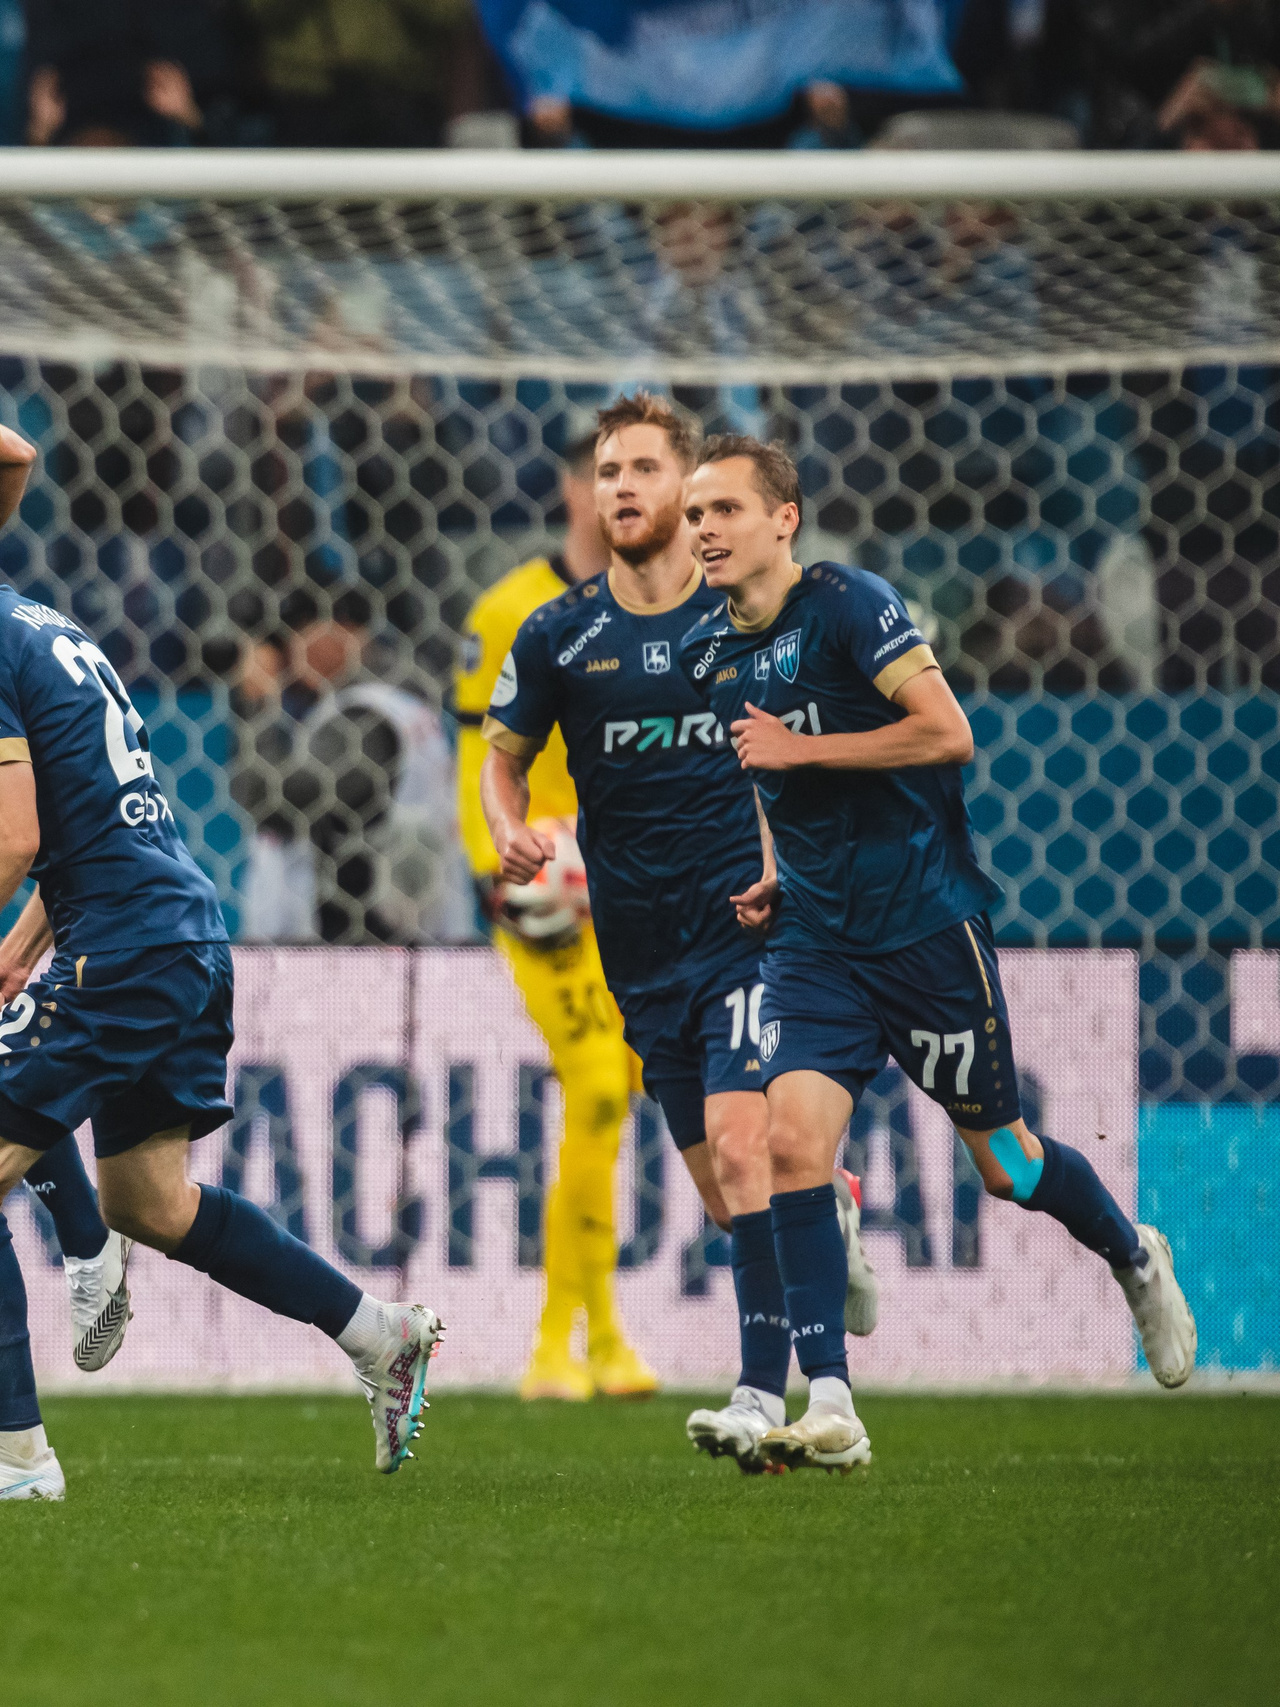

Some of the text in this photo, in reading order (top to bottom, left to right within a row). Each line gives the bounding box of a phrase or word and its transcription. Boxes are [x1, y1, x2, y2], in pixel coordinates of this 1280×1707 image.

[586, 657, 620, 673] JAKO
[910, 1029, 975, 1095] 77
[743, 1312, 790, 1330] JAKO
[790, 1323, 825, 1343] AKO
